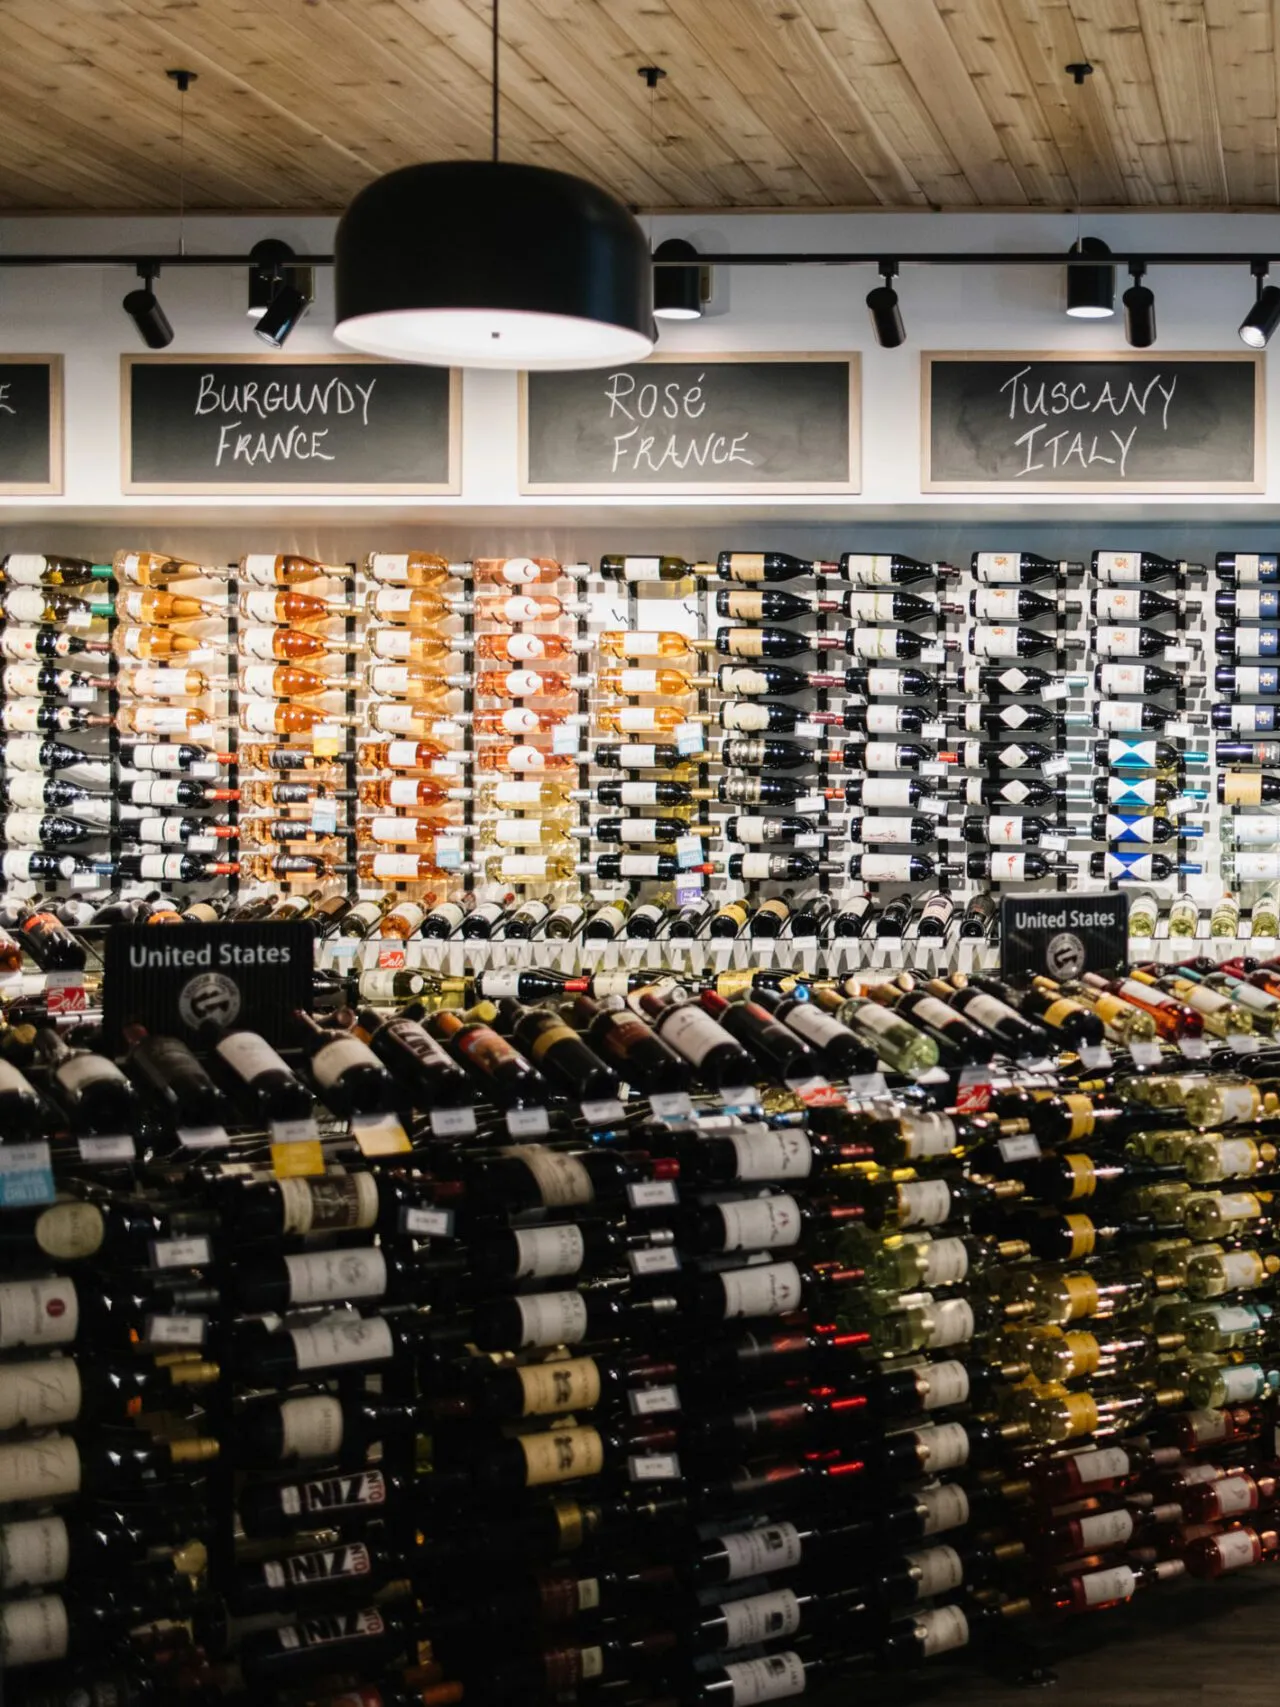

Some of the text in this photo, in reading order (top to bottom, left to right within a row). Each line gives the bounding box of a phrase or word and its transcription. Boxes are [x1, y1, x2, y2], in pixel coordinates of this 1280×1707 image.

[195, 374, 377, 426] BURGUNDY
[1000, 366, 1177, 431] TUSCANY
[215, 421, 333, 467] FRANCE
[612, 427, 755, 472] FRANCE
[1014, 423, 1138, 476] ITALY
[1015, 911, 1115, 930] United States
[130, 943, 291, 968] United States
[379, 951, 404, 968] Sale
[48, 988, 86, 1010] Sale
[957, 1086, 989, 1110] Sale
